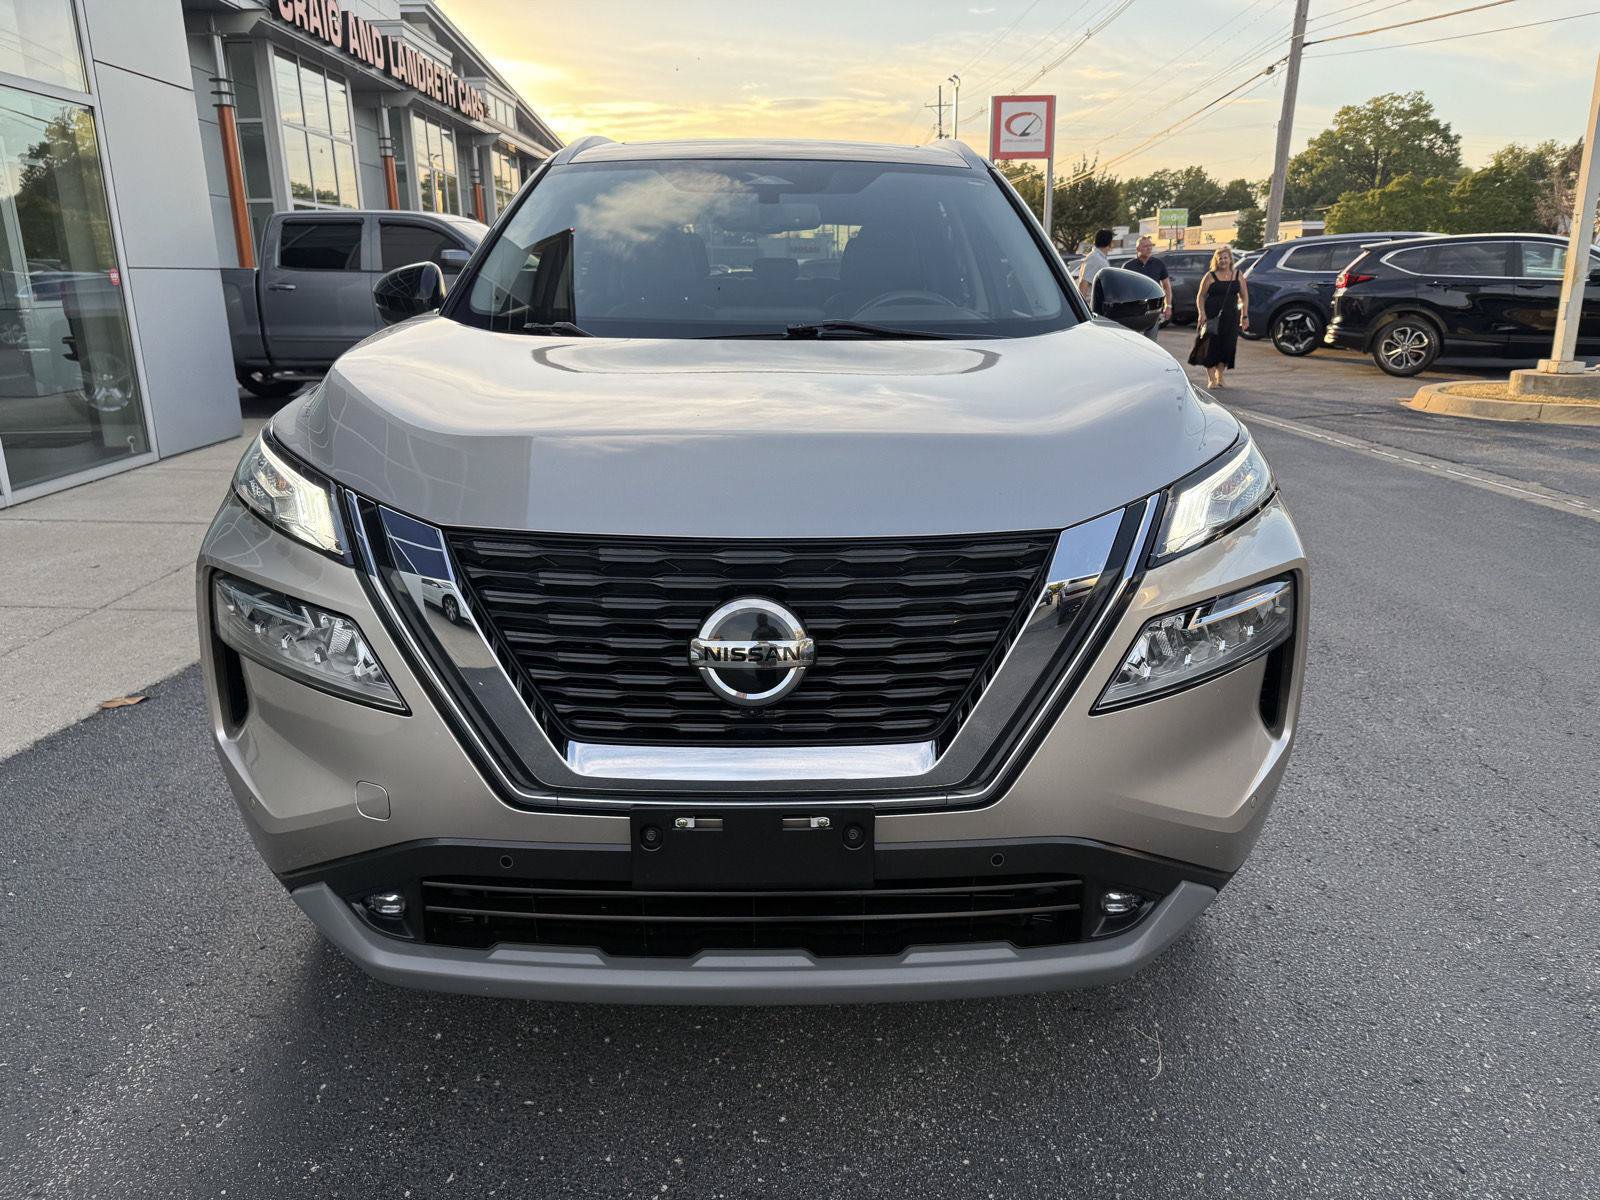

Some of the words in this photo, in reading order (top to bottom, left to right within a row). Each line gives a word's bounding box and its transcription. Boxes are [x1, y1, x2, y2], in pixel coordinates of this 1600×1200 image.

[348, 10, 384, 70] AND
[388, 33, 456, 108] LANDRETH
[458, 77, 484, 122] CARS
[704, 647, 801, 662] NISSAN
